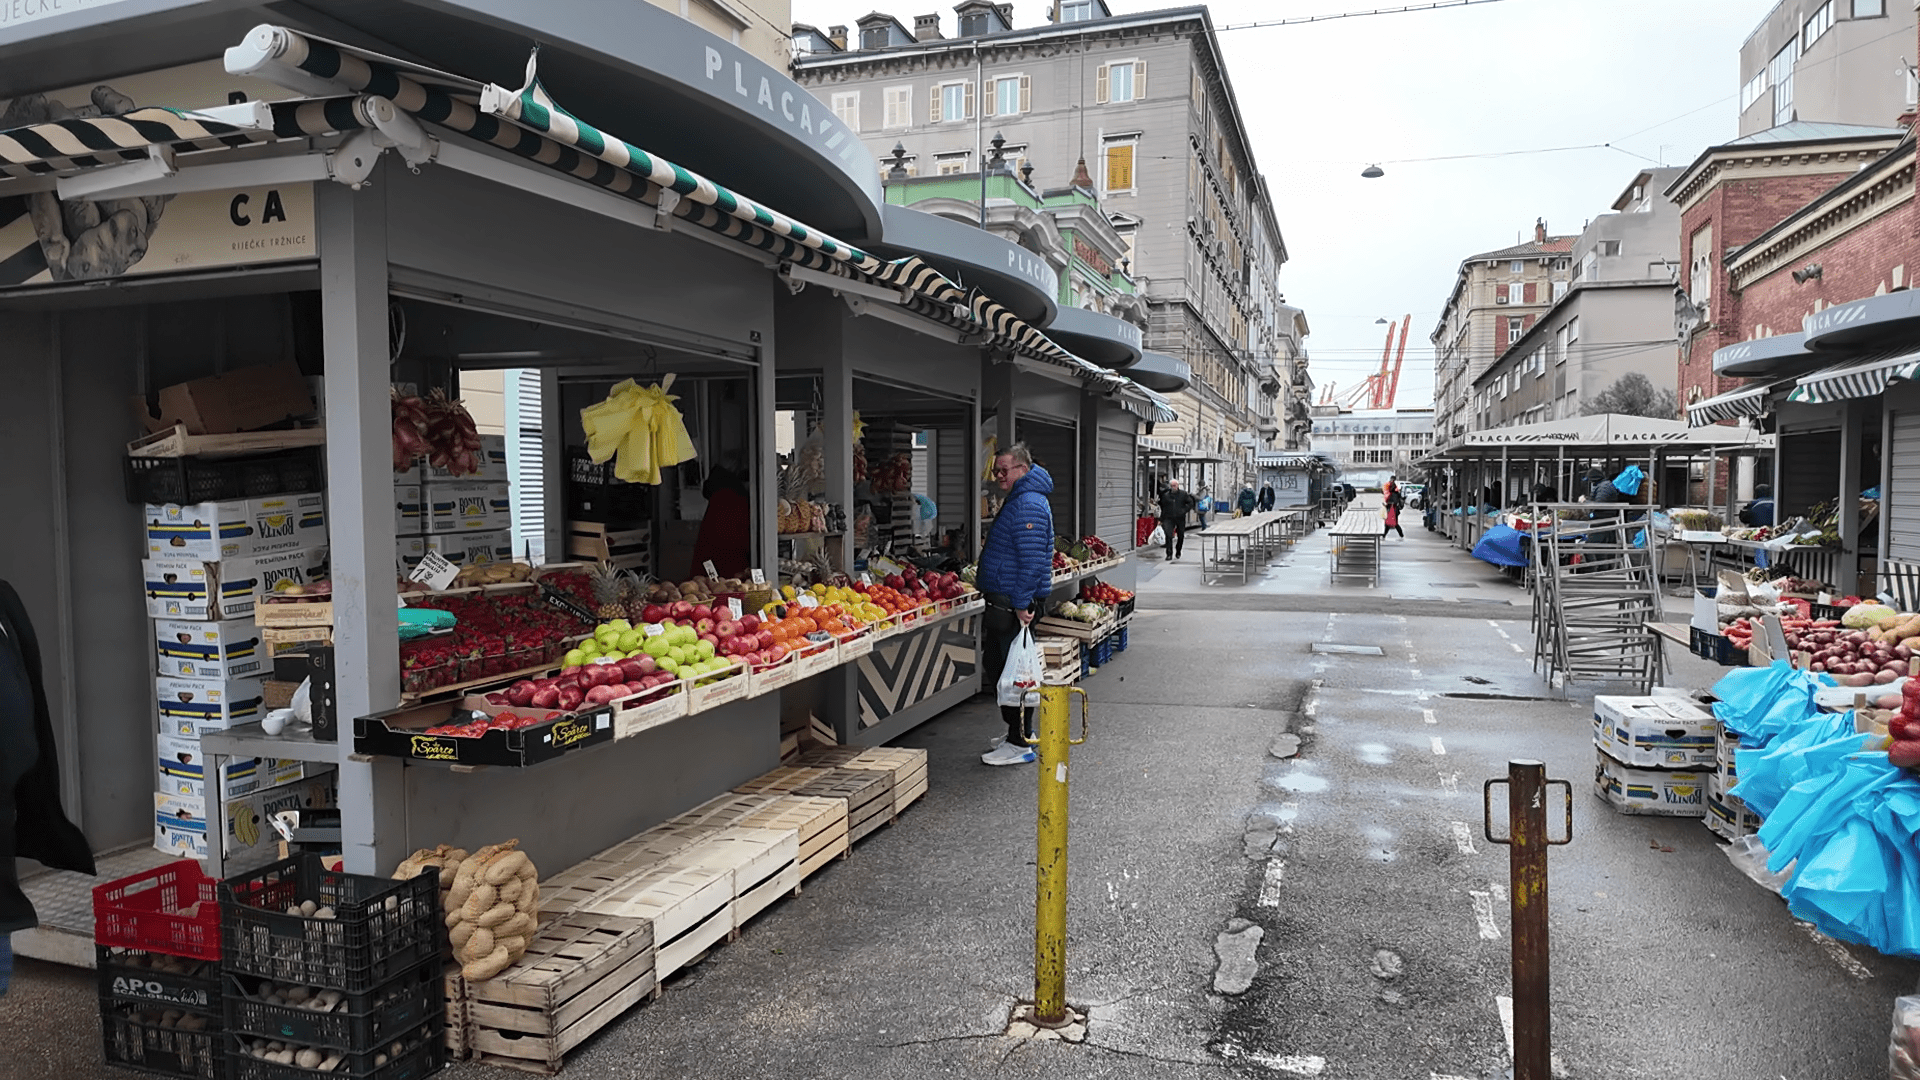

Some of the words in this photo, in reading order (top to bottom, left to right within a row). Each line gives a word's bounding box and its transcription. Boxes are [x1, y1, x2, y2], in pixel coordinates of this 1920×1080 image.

[705, 46, 813, 135] PLACA
[230, 190, 287, 227] CA
[231, 239, 266, 250] RIJEČKE
[270, 235, 307, 247] TRŽNICE
[1008, 249, 1045, 284] PLACA
[1614, 433, 1657, 441] PLACA
[459, 496, 487, 514] BONITA
[257, 515, 294, 539] BONITA
[271, 541, 299, 549] PREMIUM
[255, 555, 287, 565] PREMIUM
[288, 552, 305, 560] PACK
[263, 567, 303, 591] BONITA
[1663, 787, 1703, 805] BONITA
[171, 832, 195, 850] BONITA
[113, 977, 163, 994] APO
